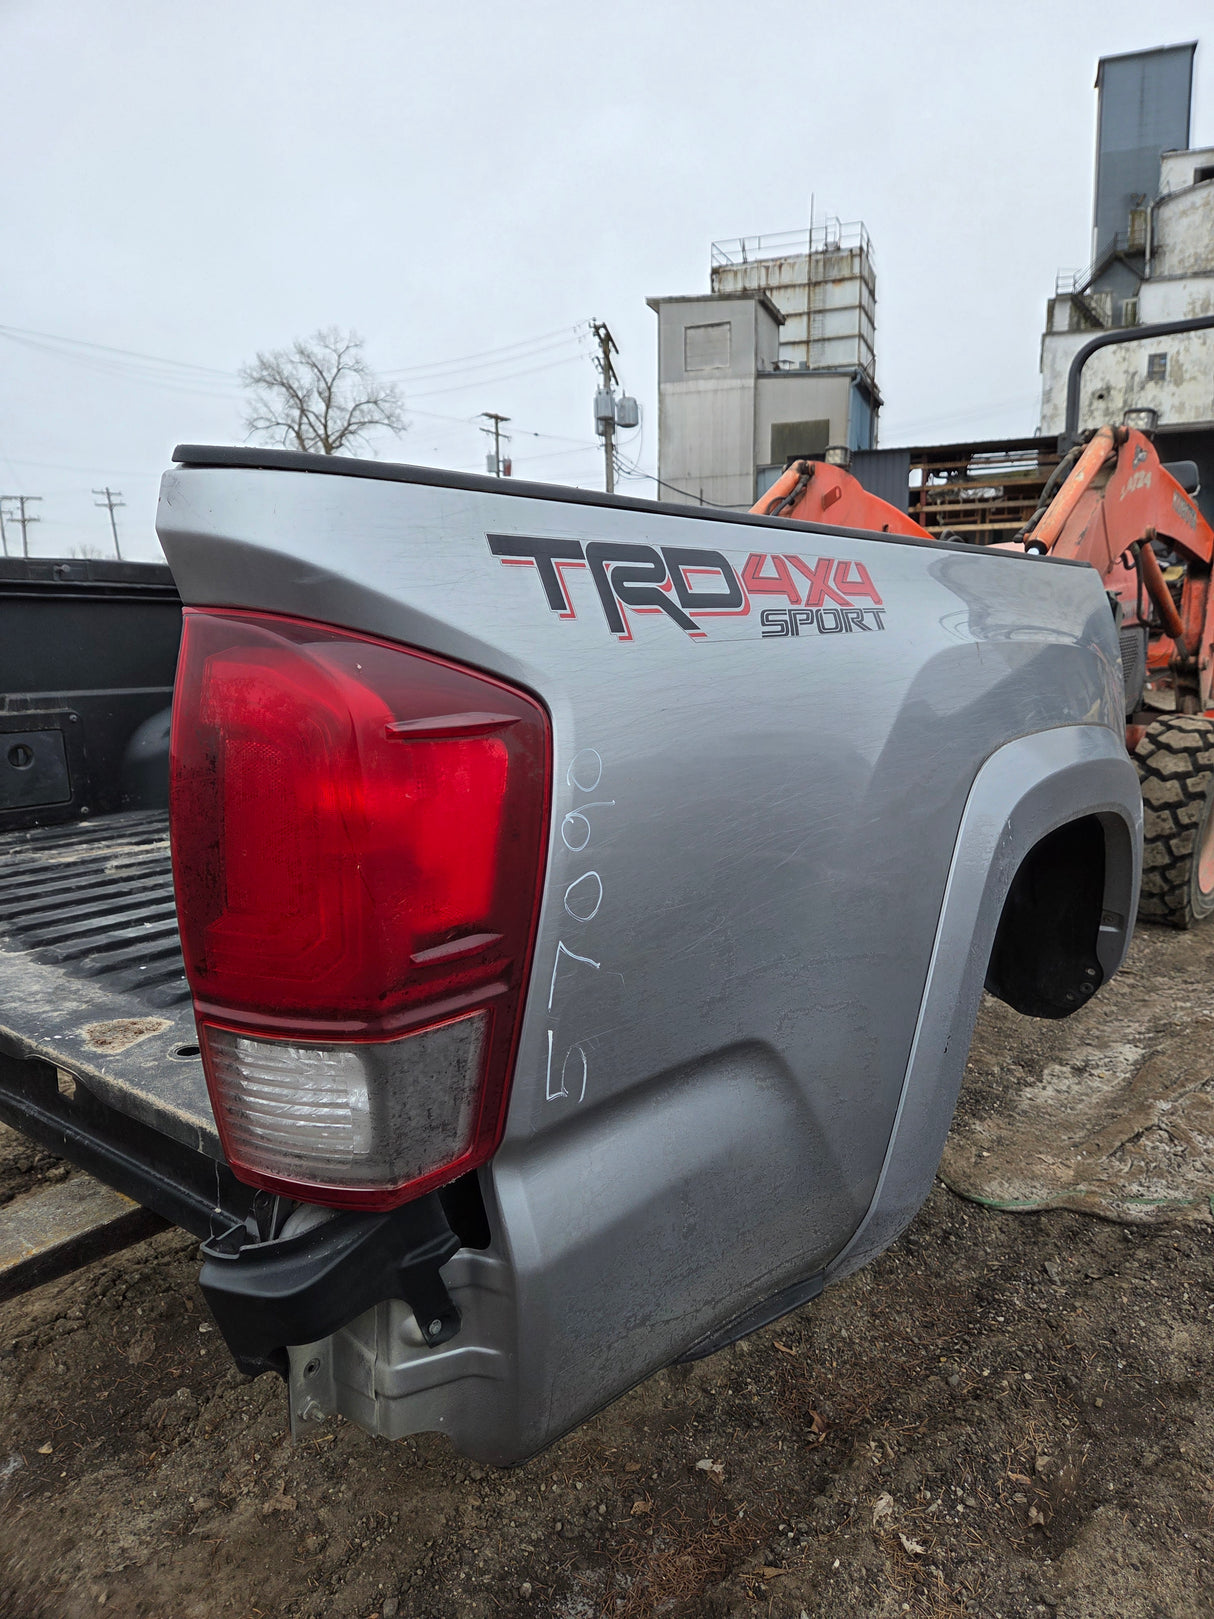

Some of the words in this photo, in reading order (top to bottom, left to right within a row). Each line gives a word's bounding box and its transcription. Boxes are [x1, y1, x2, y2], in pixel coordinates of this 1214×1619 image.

[486, 533, 750, 641] TRD
[741, 552, 883, 608] 4X4
[761, 607, 887, 638] SPORT
